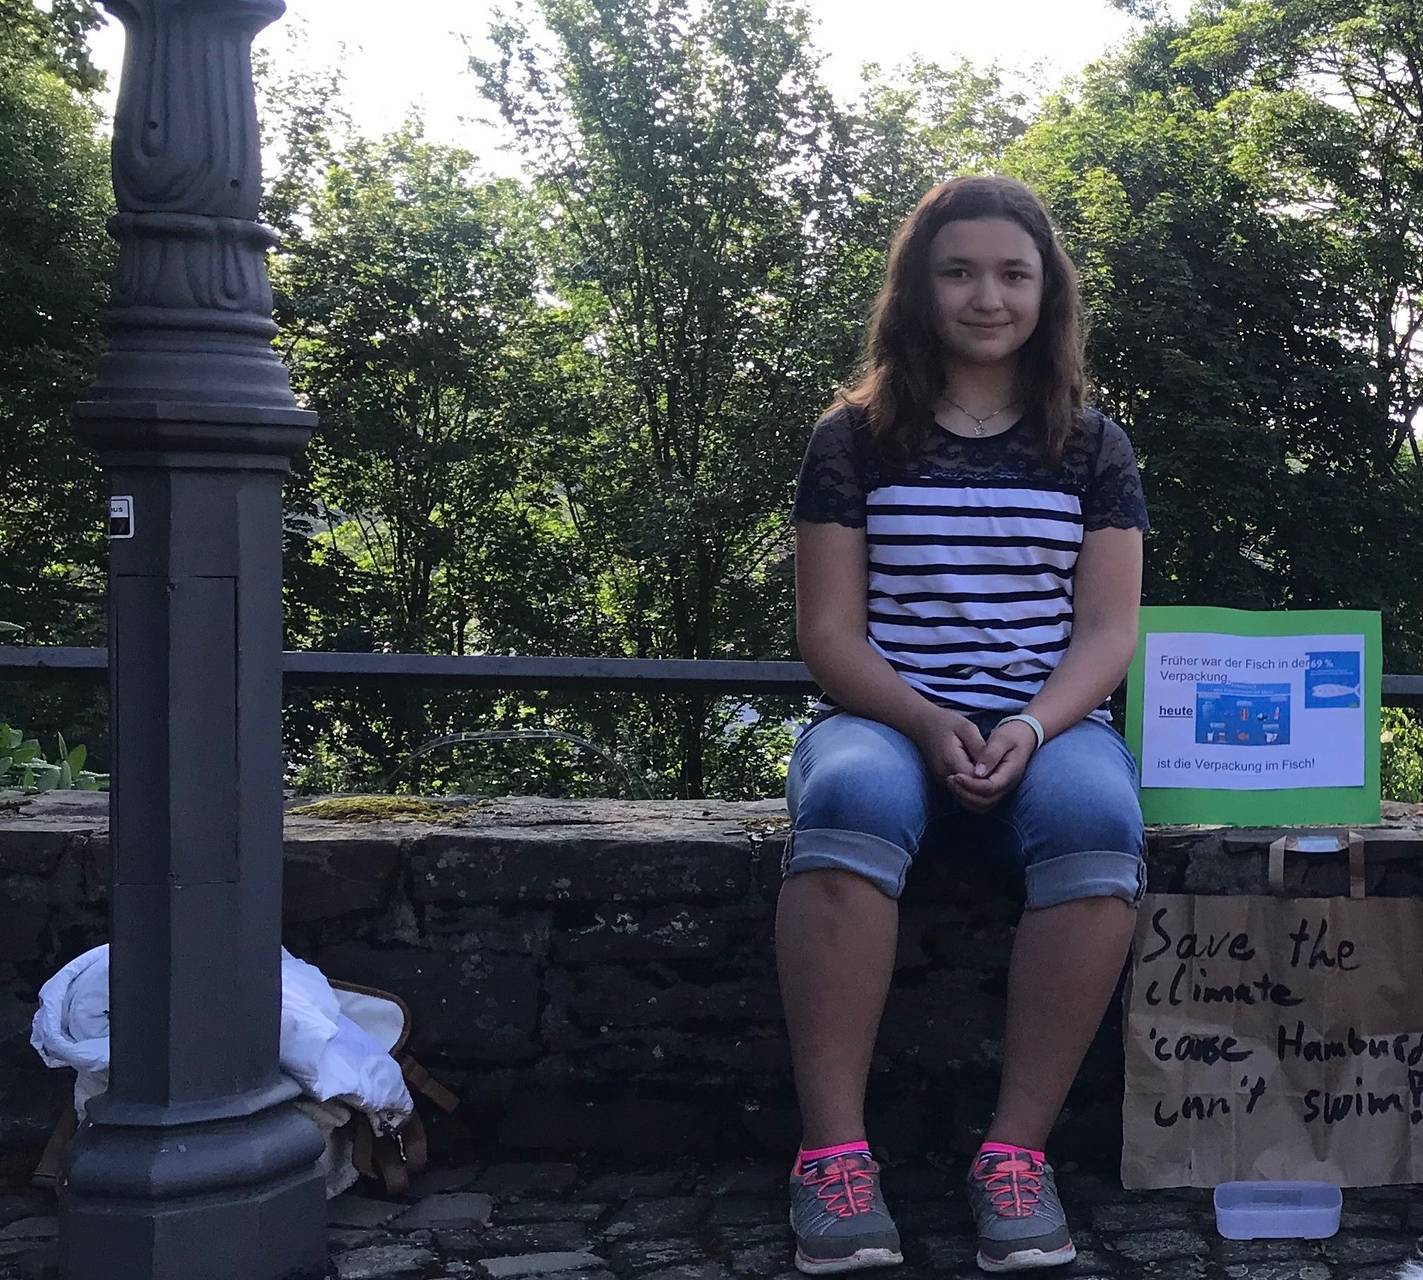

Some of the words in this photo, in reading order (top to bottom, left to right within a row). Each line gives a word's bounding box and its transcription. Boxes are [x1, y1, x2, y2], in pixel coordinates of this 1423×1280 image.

[1160, 654, 1198, 666] Früher
[1201, 657, 1222, 667] war
[1224, 658, 1242, 669] der
[1245, 658, 1275, 669] Fisch
[1278, 659, 1289, 669] in
[1291, 657, 1310, 669] der
[1159, 705, 1193, 718] heute
[1157, 757, 1171, 769] ist
[1173, 757, 1191, 769] die
[1195, 758, 1262, 773] Verpackung
[1265, 760, 1279, 770] im
[1282, 757, 1315, 770] Fisch!
[1142, 907, 1256, 963] Save
[1289, 919, 1360, 971] the
[1145, 963, 1303, 1007] climate
[1153, 1075, 1266, 1127] can't
